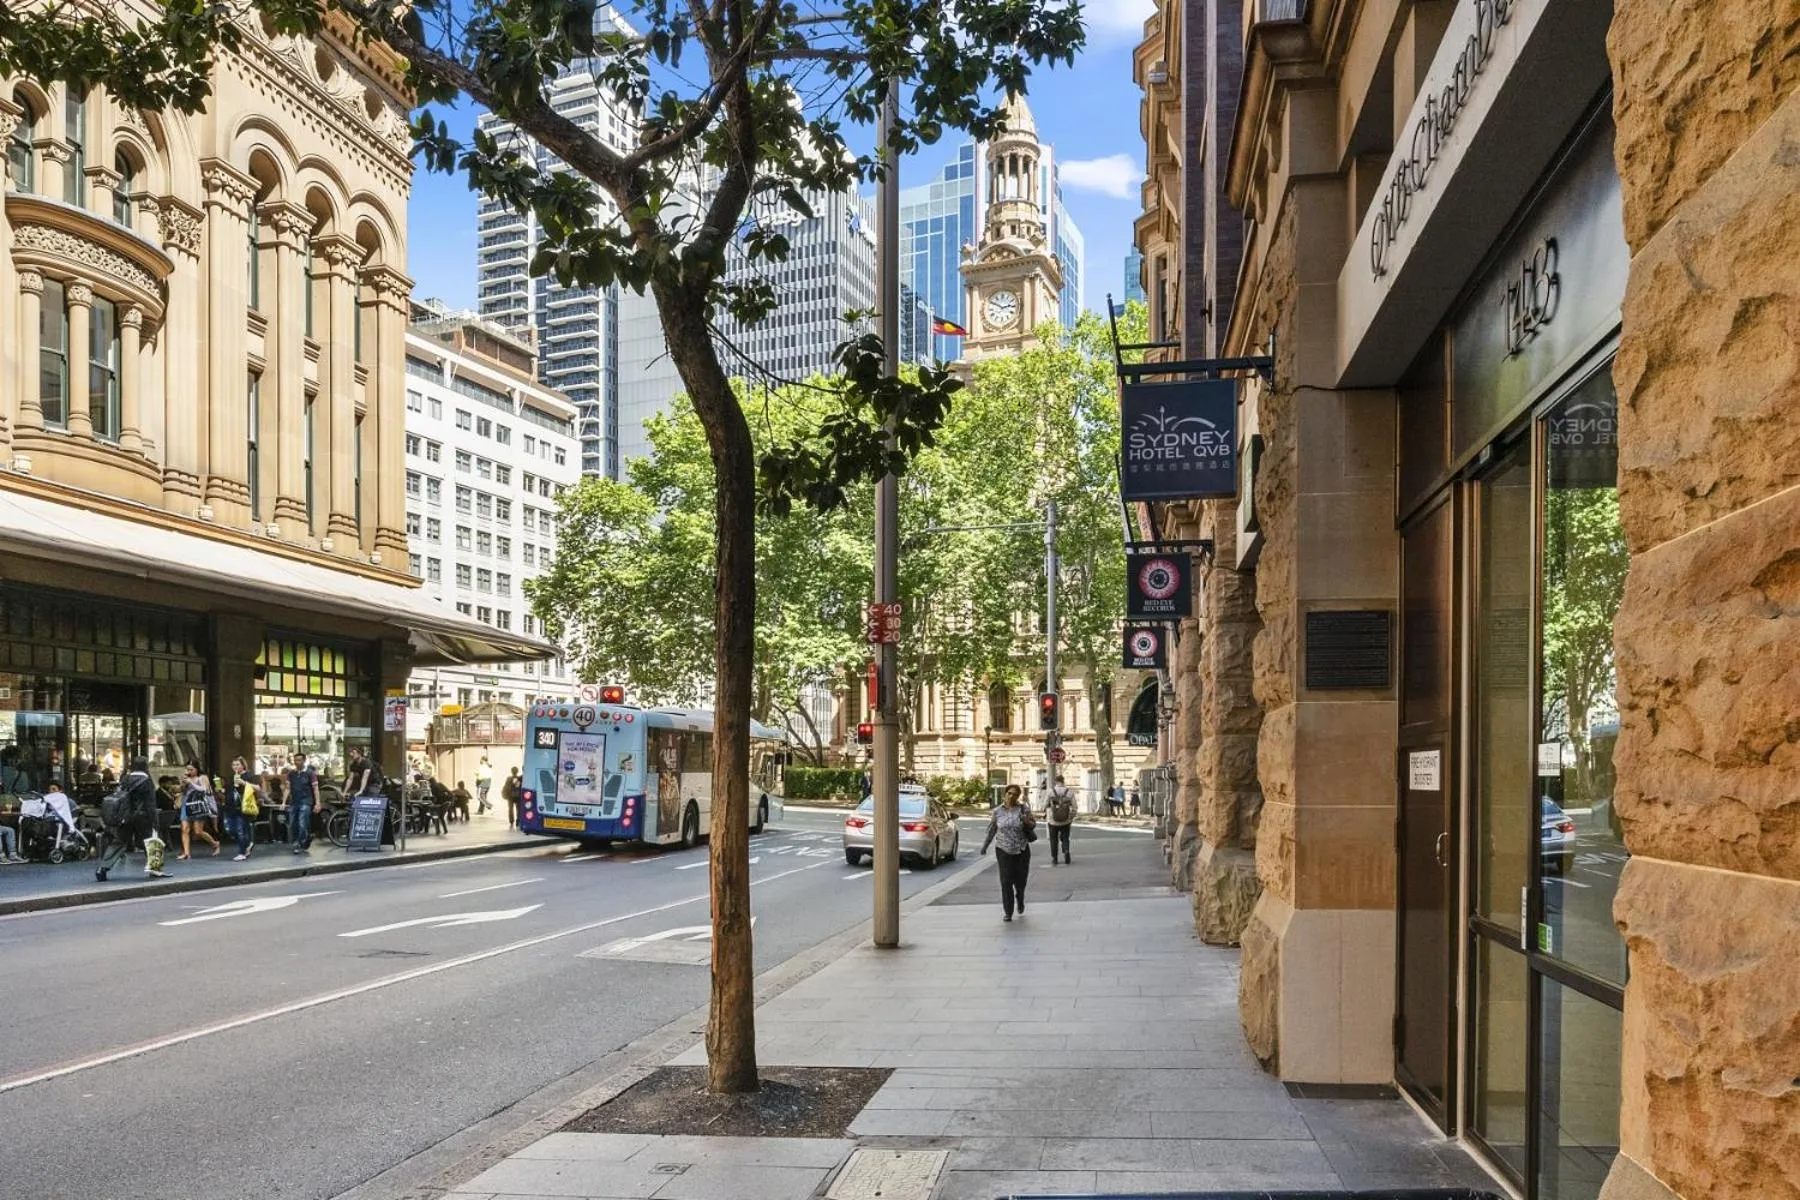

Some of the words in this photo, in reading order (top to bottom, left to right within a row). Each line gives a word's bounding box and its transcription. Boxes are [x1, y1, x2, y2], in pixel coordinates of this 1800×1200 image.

[1129, 430, 1231, 449] SYDNEY
[1129, 447, 1185, 461] HOTEL
[1193, 444, 1231, 458] QVB
[884, 603, 902, 615] 40
[886, 617, 901, 629] 30
[883, 631, 901, 642] 20
[575, 710, 593, 722] 40
[538, 731, 555, 746] 340
